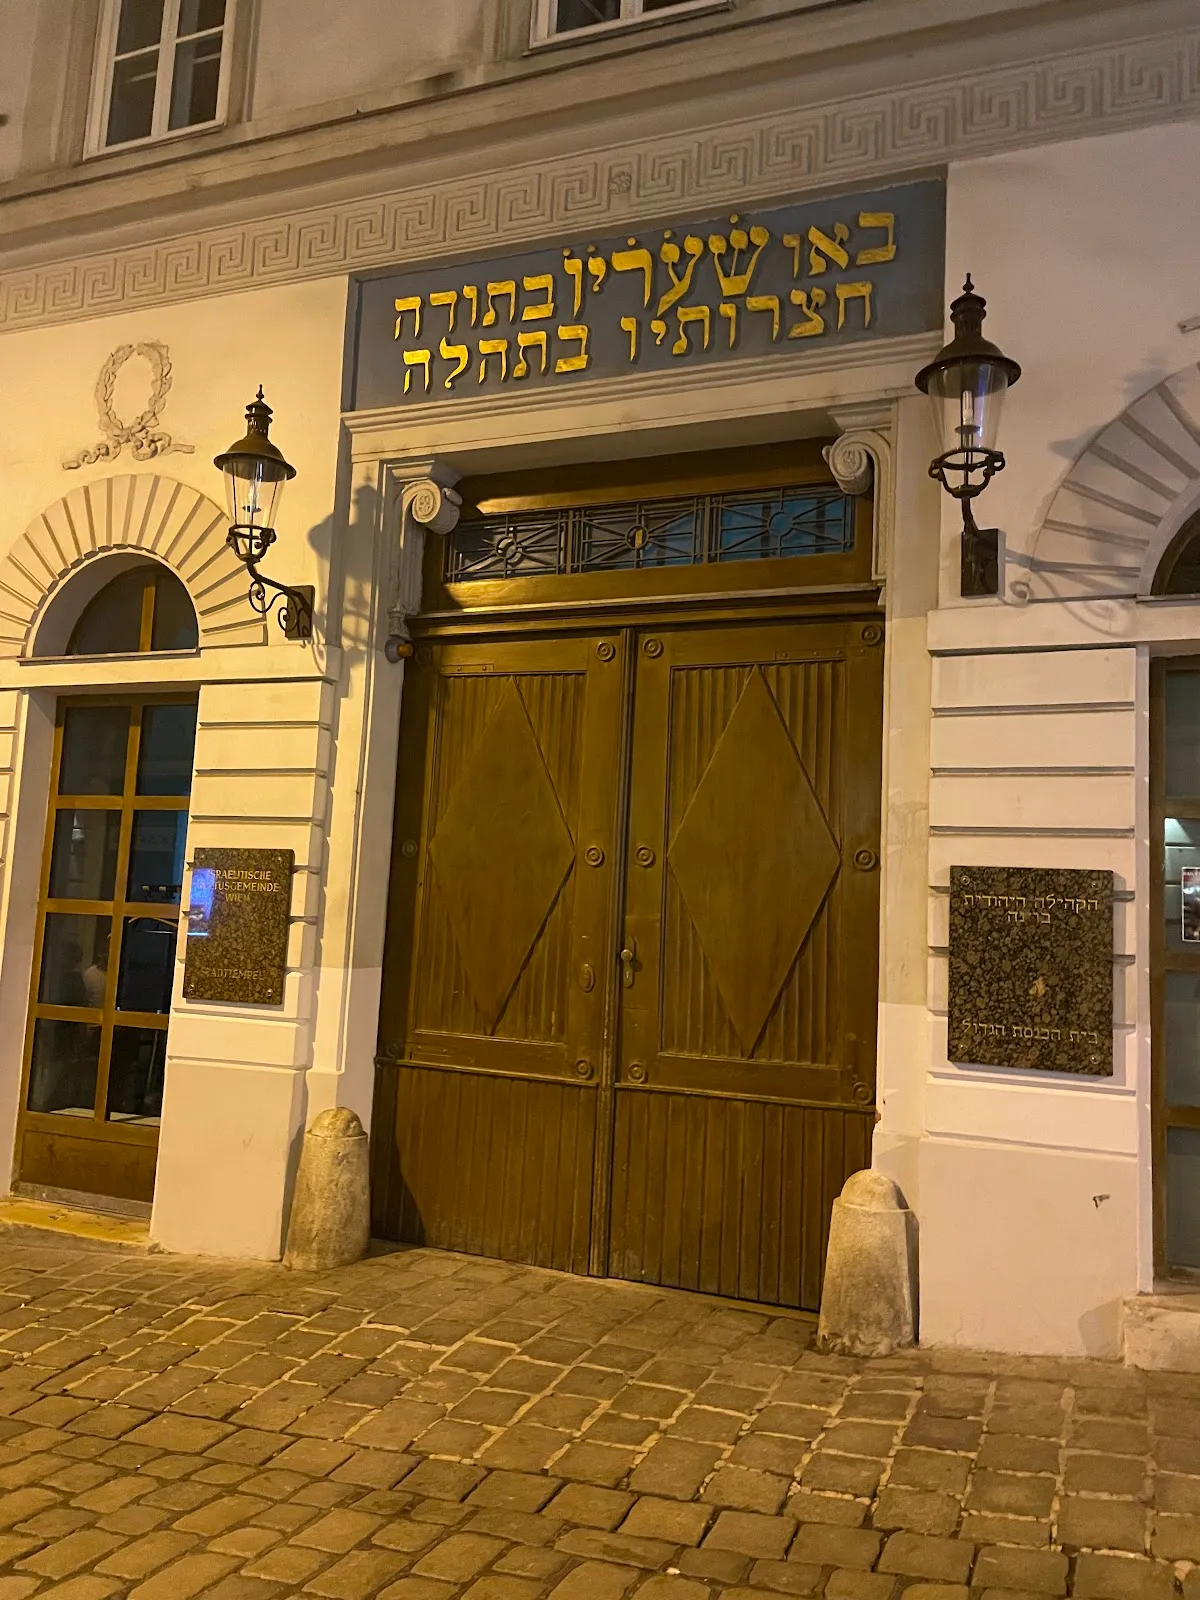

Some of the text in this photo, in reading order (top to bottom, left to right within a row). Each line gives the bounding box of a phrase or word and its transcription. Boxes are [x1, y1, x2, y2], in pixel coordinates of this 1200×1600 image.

[783, 211, 896, 279] באו
[394, 273, 555, 340] בתודה
[403, 281, 873, 394] חצרותיו בתהלה
[196, 880, 280, 893] TUSGEMEINDE
[207, 868, 272, 881] SRAELITISCHE
[225, 892, 251, 903] WIEN
[964, 893, 1099, 914] הקהילה היהודית
[962, 1018, 1098, 1045] בית הכנסת הגדול
